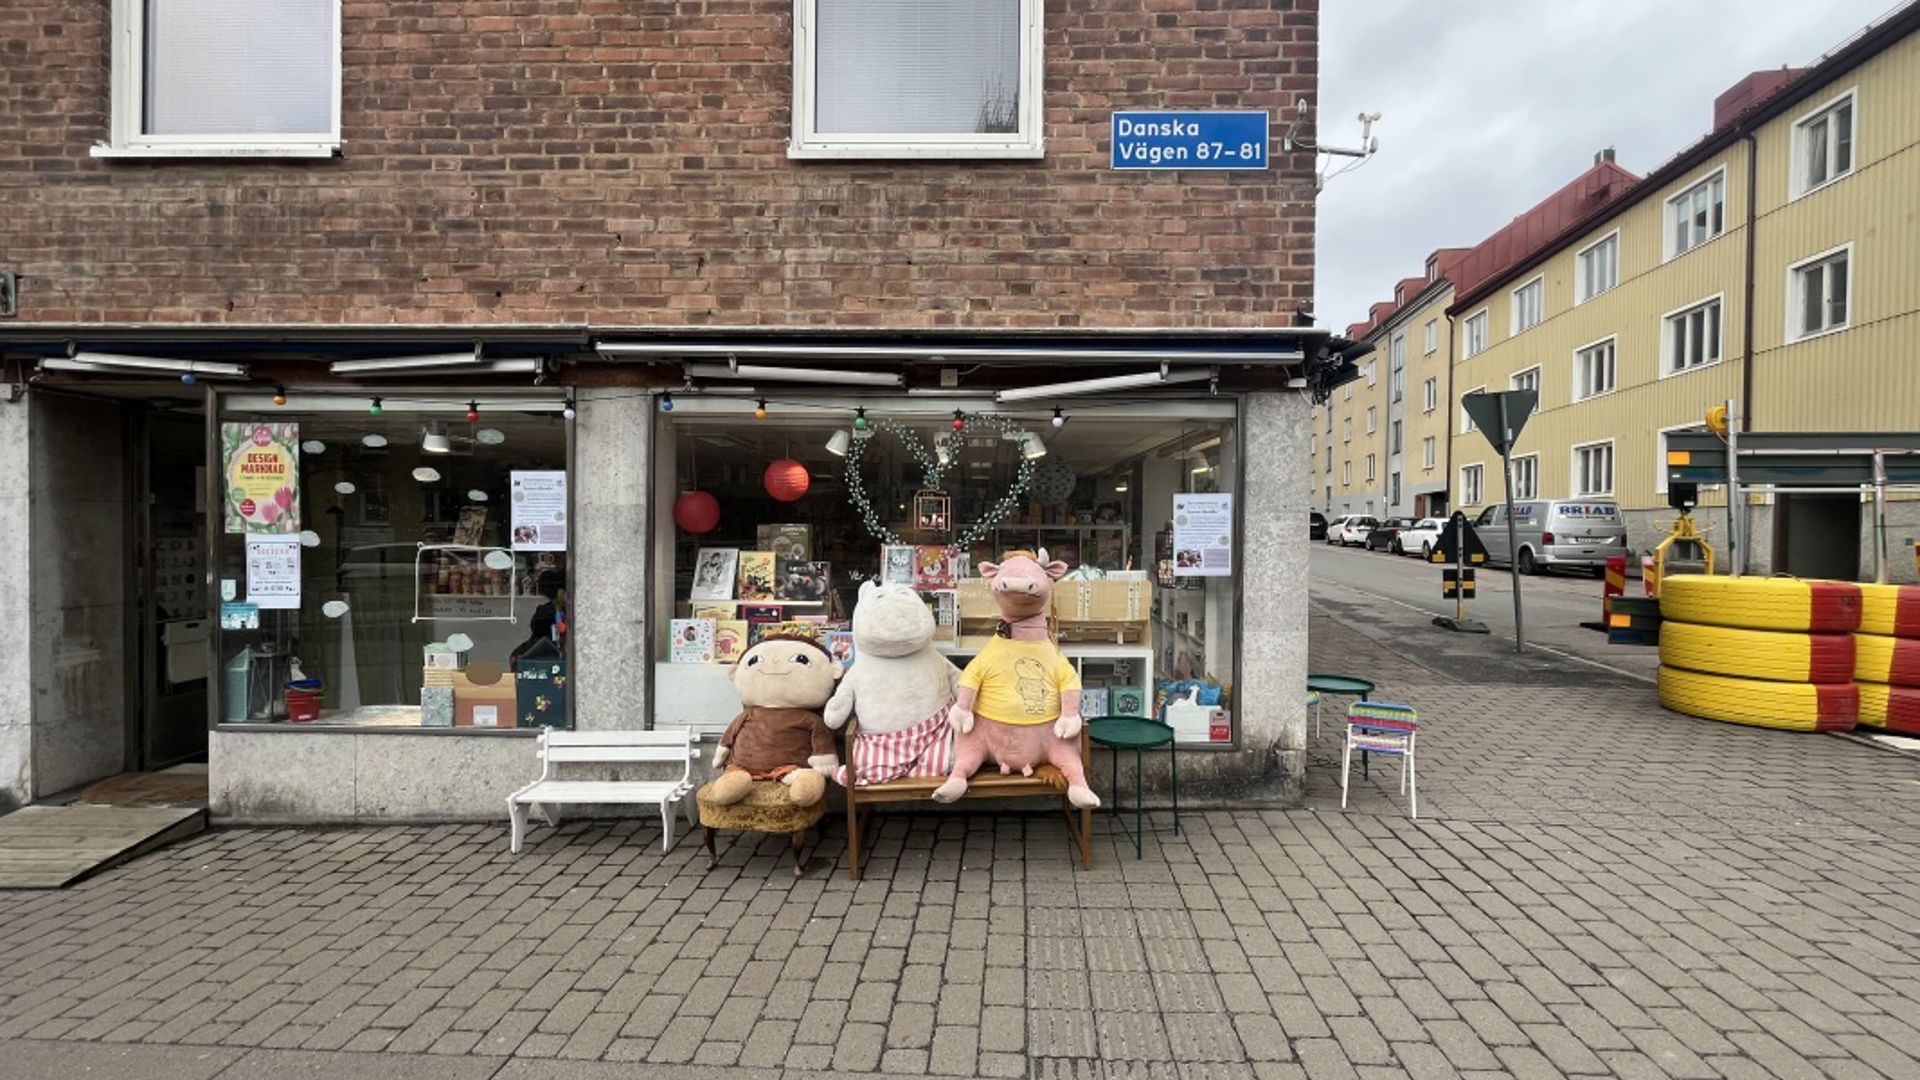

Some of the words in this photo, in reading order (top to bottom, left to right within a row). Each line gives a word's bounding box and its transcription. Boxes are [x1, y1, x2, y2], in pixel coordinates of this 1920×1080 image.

[1118, 119, 1200, 137] Danska
[1119, 142, 1188, 164] Vägen
[248, 453, 278, 463] DESIGN
[241, 464, 285, 474] MARKNAD
[1559, 506, 1615, 515] BRIAB
